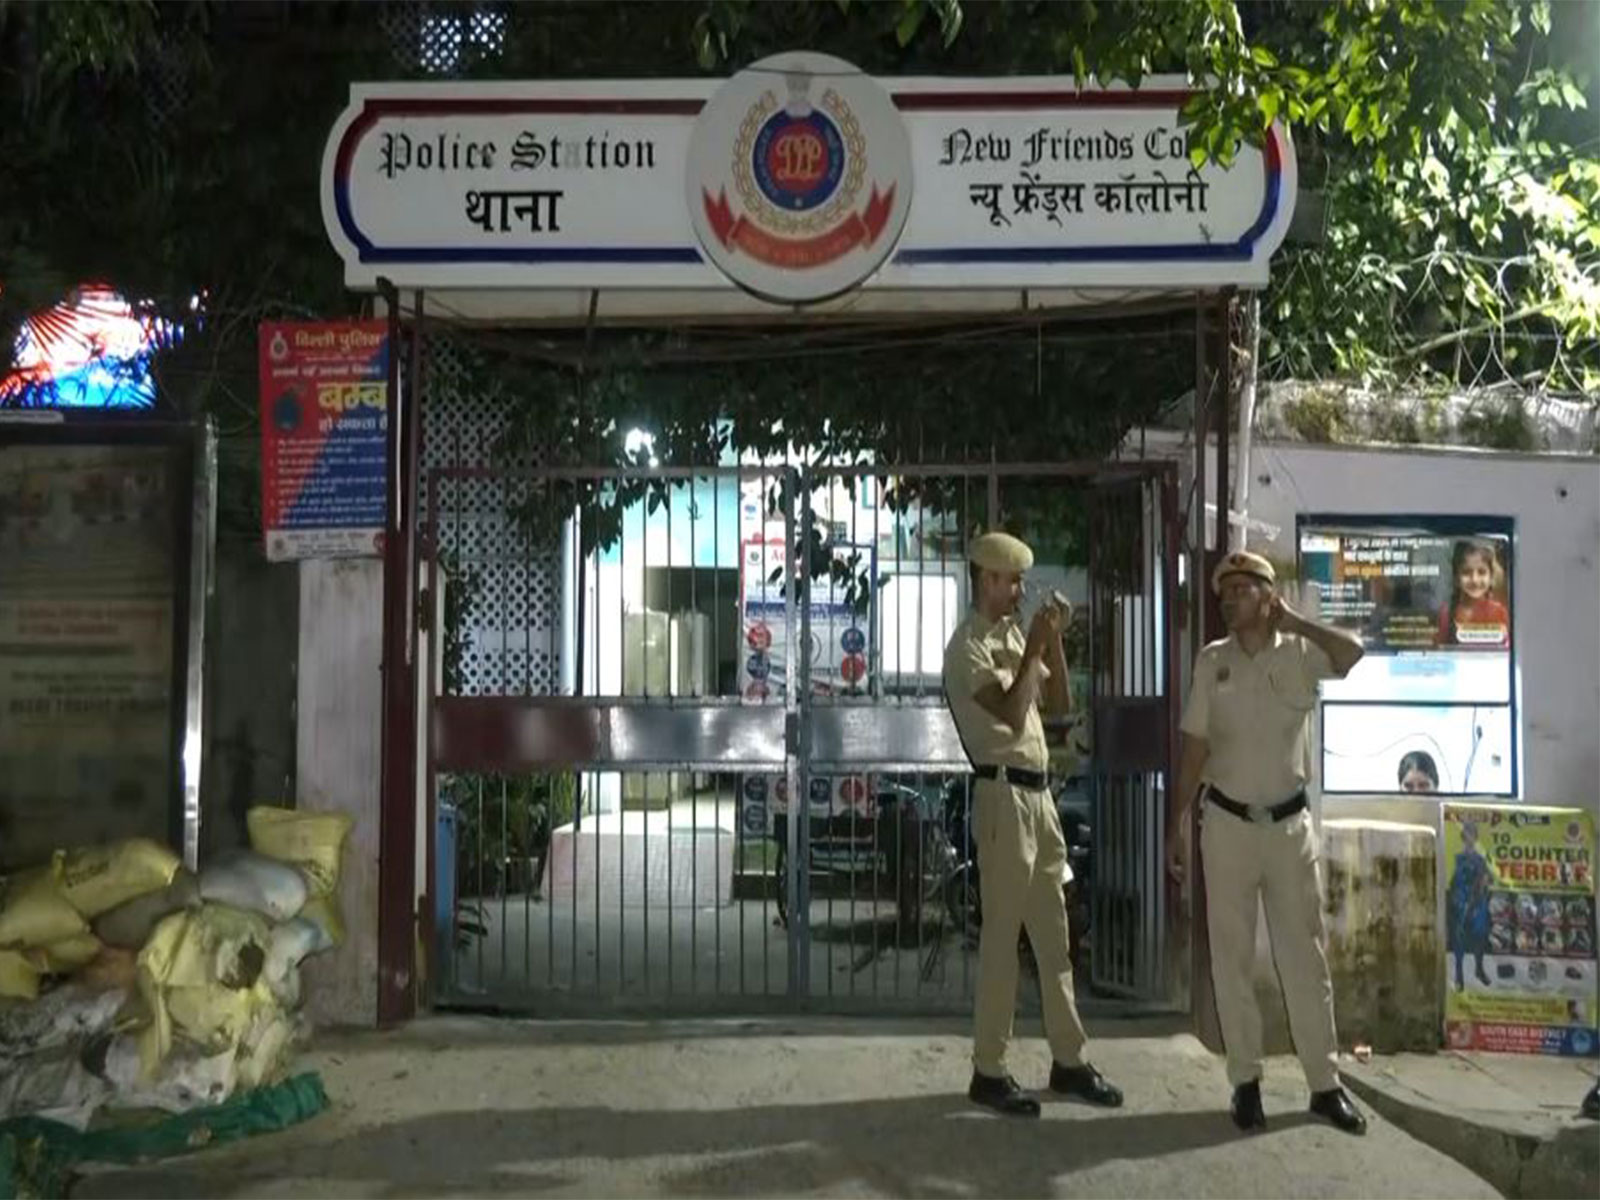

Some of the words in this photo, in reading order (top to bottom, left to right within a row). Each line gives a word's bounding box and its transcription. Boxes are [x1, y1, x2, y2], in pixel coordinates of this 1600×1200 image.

[377, 132, 497, 178] Police
[511, 130, 657, 171] Station
[939, 127, 1011, 165] New
[1022, 127, 1136, 167] Friends
[465, 189, 564, 233] थाना
[969, 182, 1012, 226] न्यू
[1013, 171, 1086, 228] फ्रेंड्स
[1094, 169, 1210, 213] कॉलोनी
